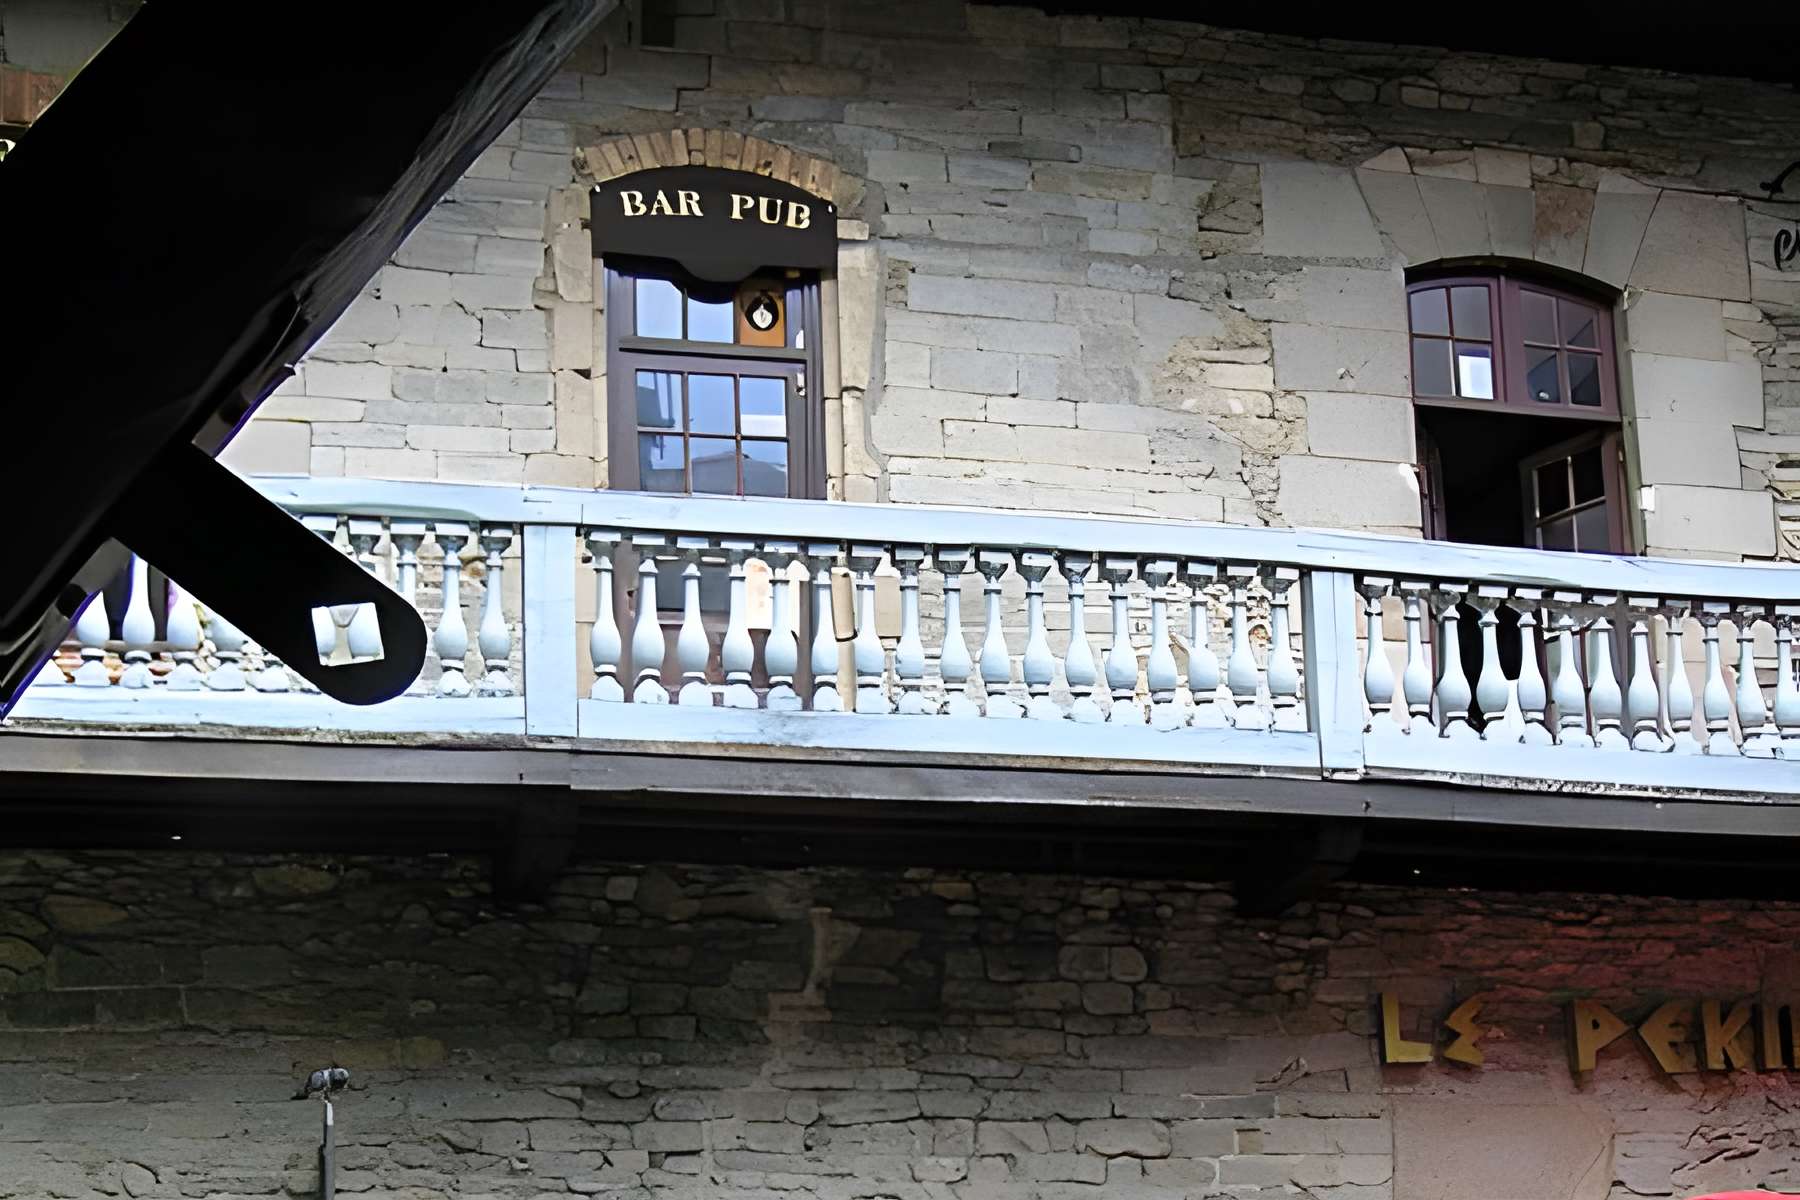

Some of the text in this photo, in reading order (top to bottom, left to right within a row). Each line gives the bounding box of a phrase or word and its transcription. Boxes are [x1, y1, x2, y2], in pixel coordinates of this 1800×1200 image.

[620, 189, 811, 229] BAR PUB
[1381, 992, 1800, 1074] LE PEKI
